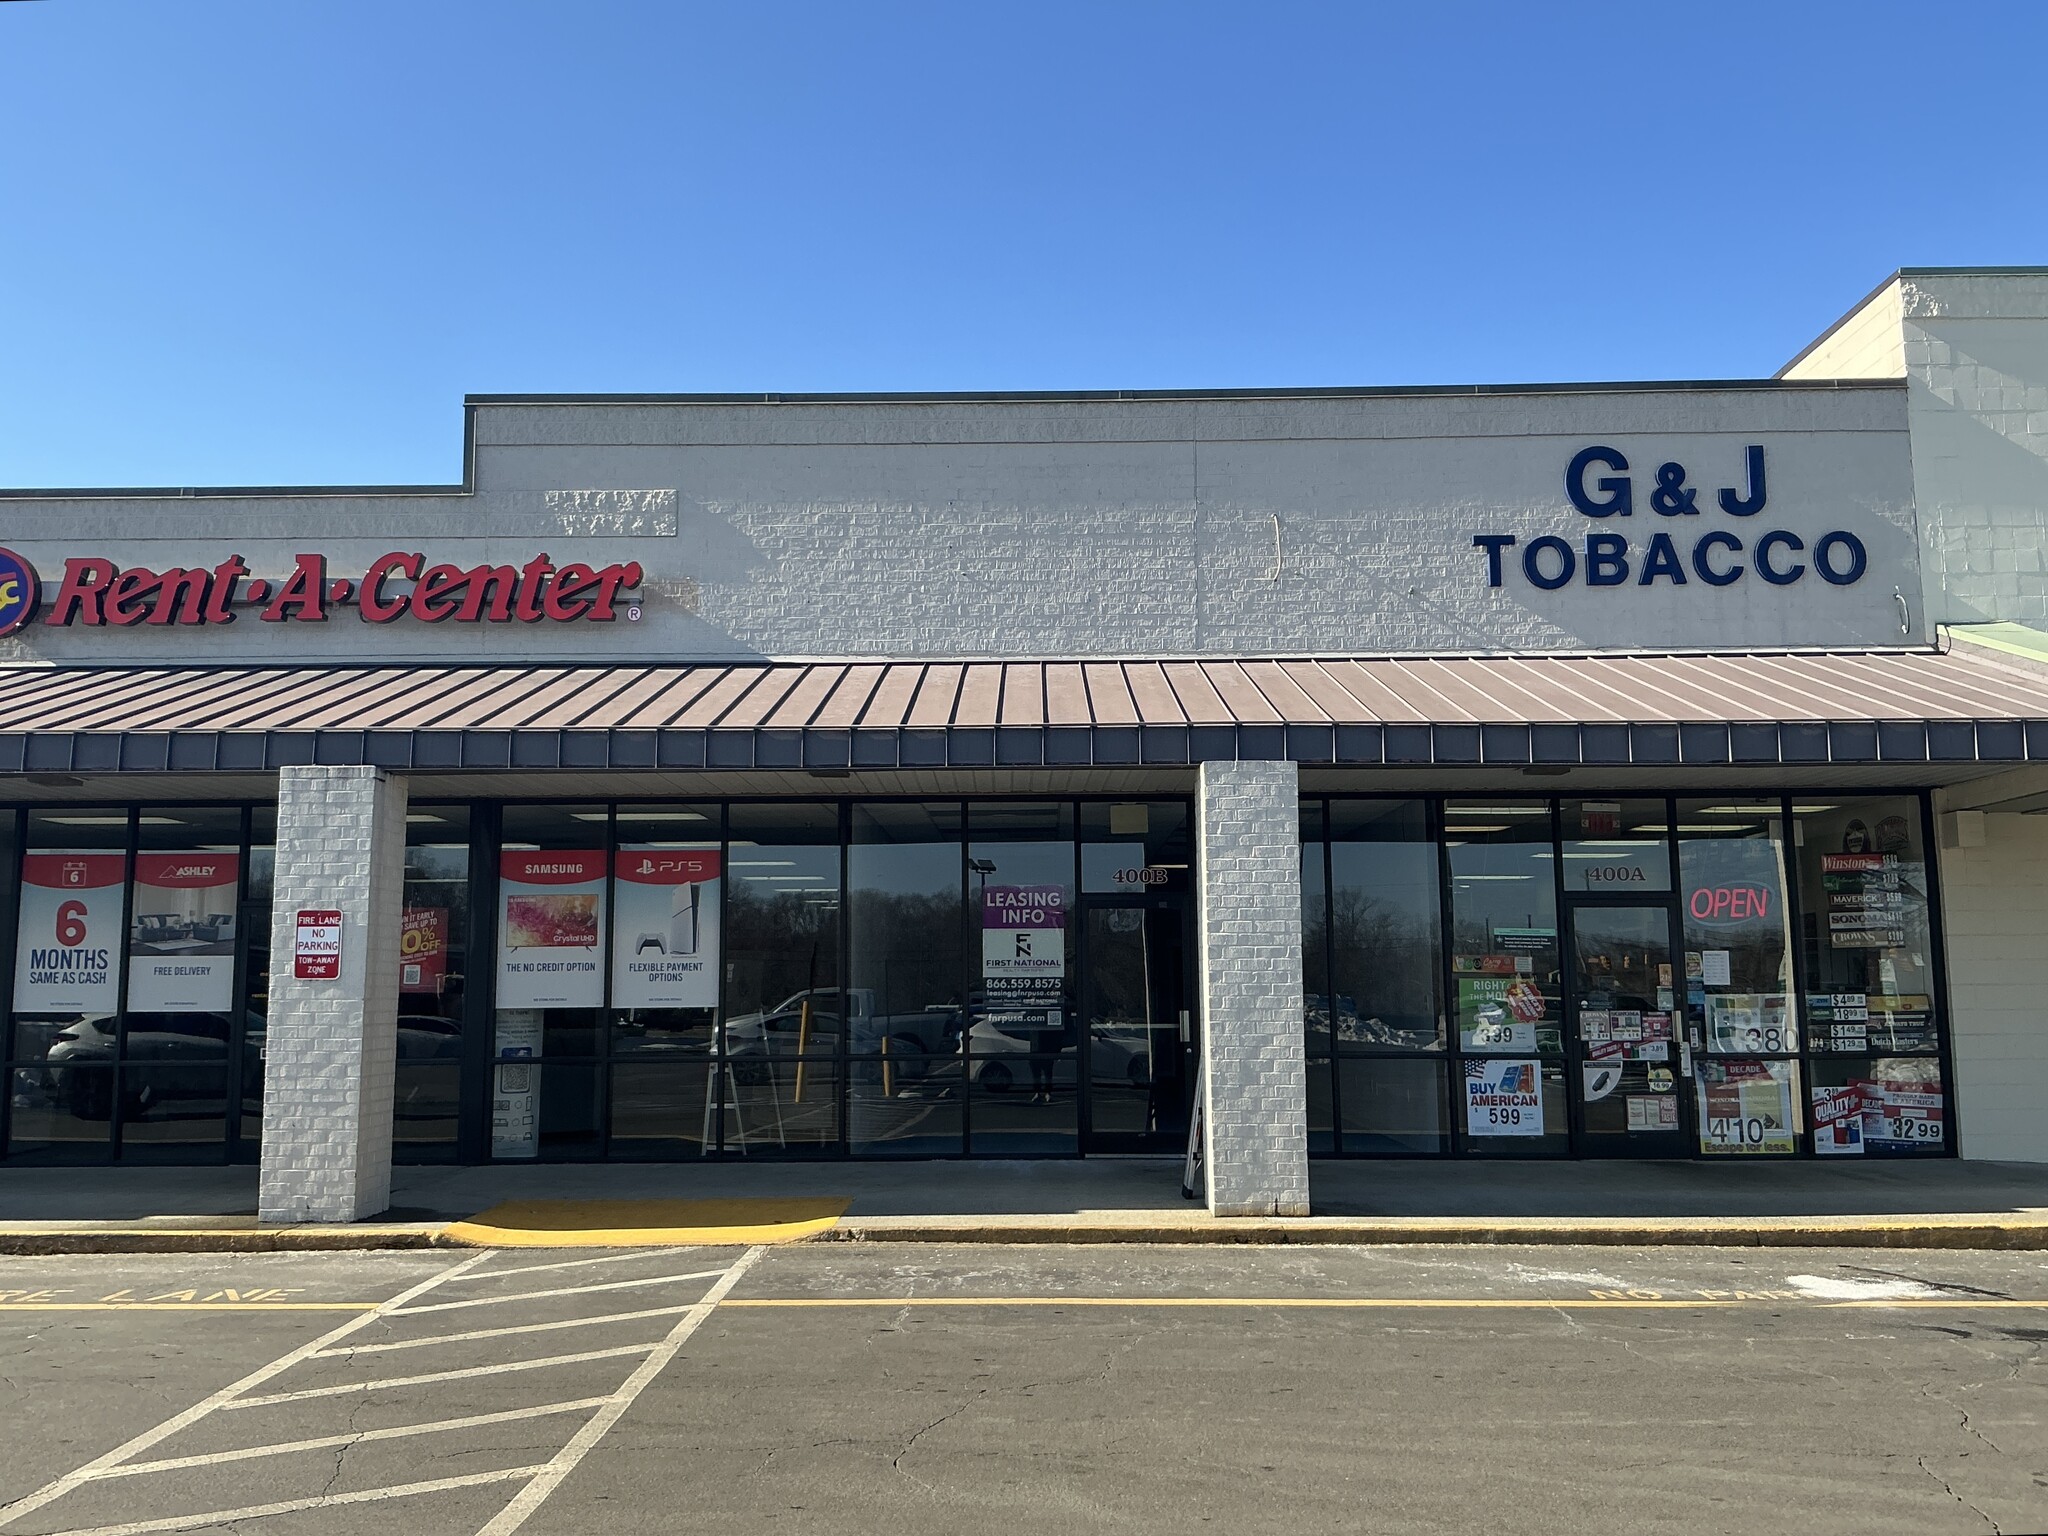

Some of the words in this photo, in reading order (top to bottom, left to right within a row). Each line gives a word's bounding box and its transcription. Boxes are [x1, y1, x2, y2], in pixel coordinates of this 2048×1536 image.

[1472, 529, 1868, 590] TOBACCO
[660, 860, 703, 872] PS5
[1824, 856, 1866, 870] Winston
[176, 866, 217, 877] ASHLEY
[525, 863, 583, 875] SAMSUNG
[1590, 865, 1647, 882] 400A
[69, 870, 80, 883] 6
[1112, 867, 1169, 885] 400B
[986, 892, 1061, 907] LEASING
[1690, 888, 1768, 919] OPEN
[1833, 894, 1878, 903] MAVERICK
[298, 916, 315, 925] FIRE
[318, 916, 340, 925] LANE
[1002, 909, 1046, 924] INFO
[55, 900, 88, 947] 6
[404, 920, 419, 930] SAVE
[311, 928, 326, 938] NO
[1832, 931, 1876, 944] CROWNS
[553, 934, 579, 944] Crystal
[298, 940, 339, 951] PARKING
[420, 939, 442, 951] OFF
[30, 948, 109, 970] MONTHS
[299, 956, 337, 965] TOW-AWAY
[986, 959, 1012, 967] FIRST
[1013, 959, 1062, 967] NATIONAL
[153, 966, 173, 976] FREE
[174, 966, 212, 977] DELIVERY
[307, 965, 326, 974] ZONE
[507, 963, 521, 973] THE
[523, 963, 535, 972] NO
[536, 962, 565, 972] CREDIT
[566, 962, 596, 972] OPTION
[629, 962, 665, 972] FLEXIBLE
[666, 962, 703, 972] PAYMENT
[30, 971, 59, 985] SAME
[61, 971, 76, 985] AS
[78, 971, 107, 985] CASH
[648, 972, 684, 982] OPTIONS
[986, 978, 1062, 989] 866.559.8575
[1473, 980, 1506, 991] RIGHT
[986, 989, 1062, 998] leasing@fnrpusa.com
[1469, 993, 1484, 1001] THE
[987, 1013, 1046, 1024] fnrpusa.com
[1892, 1037, 1919, 1046] asters
[1729, 1064, 1761, 1074] DECADE
[1470, 1083, 1497, 1095] BUY
[1471, 1094, 1539, 1107] AMERICAN
[1814, 1095, 1850, 1121] QUALITY
[1489, 1108, 1521, 1125] 599
[1704, 1141, 1746, 1153] Escape
[99, 1288, 306, 1302] LANE
